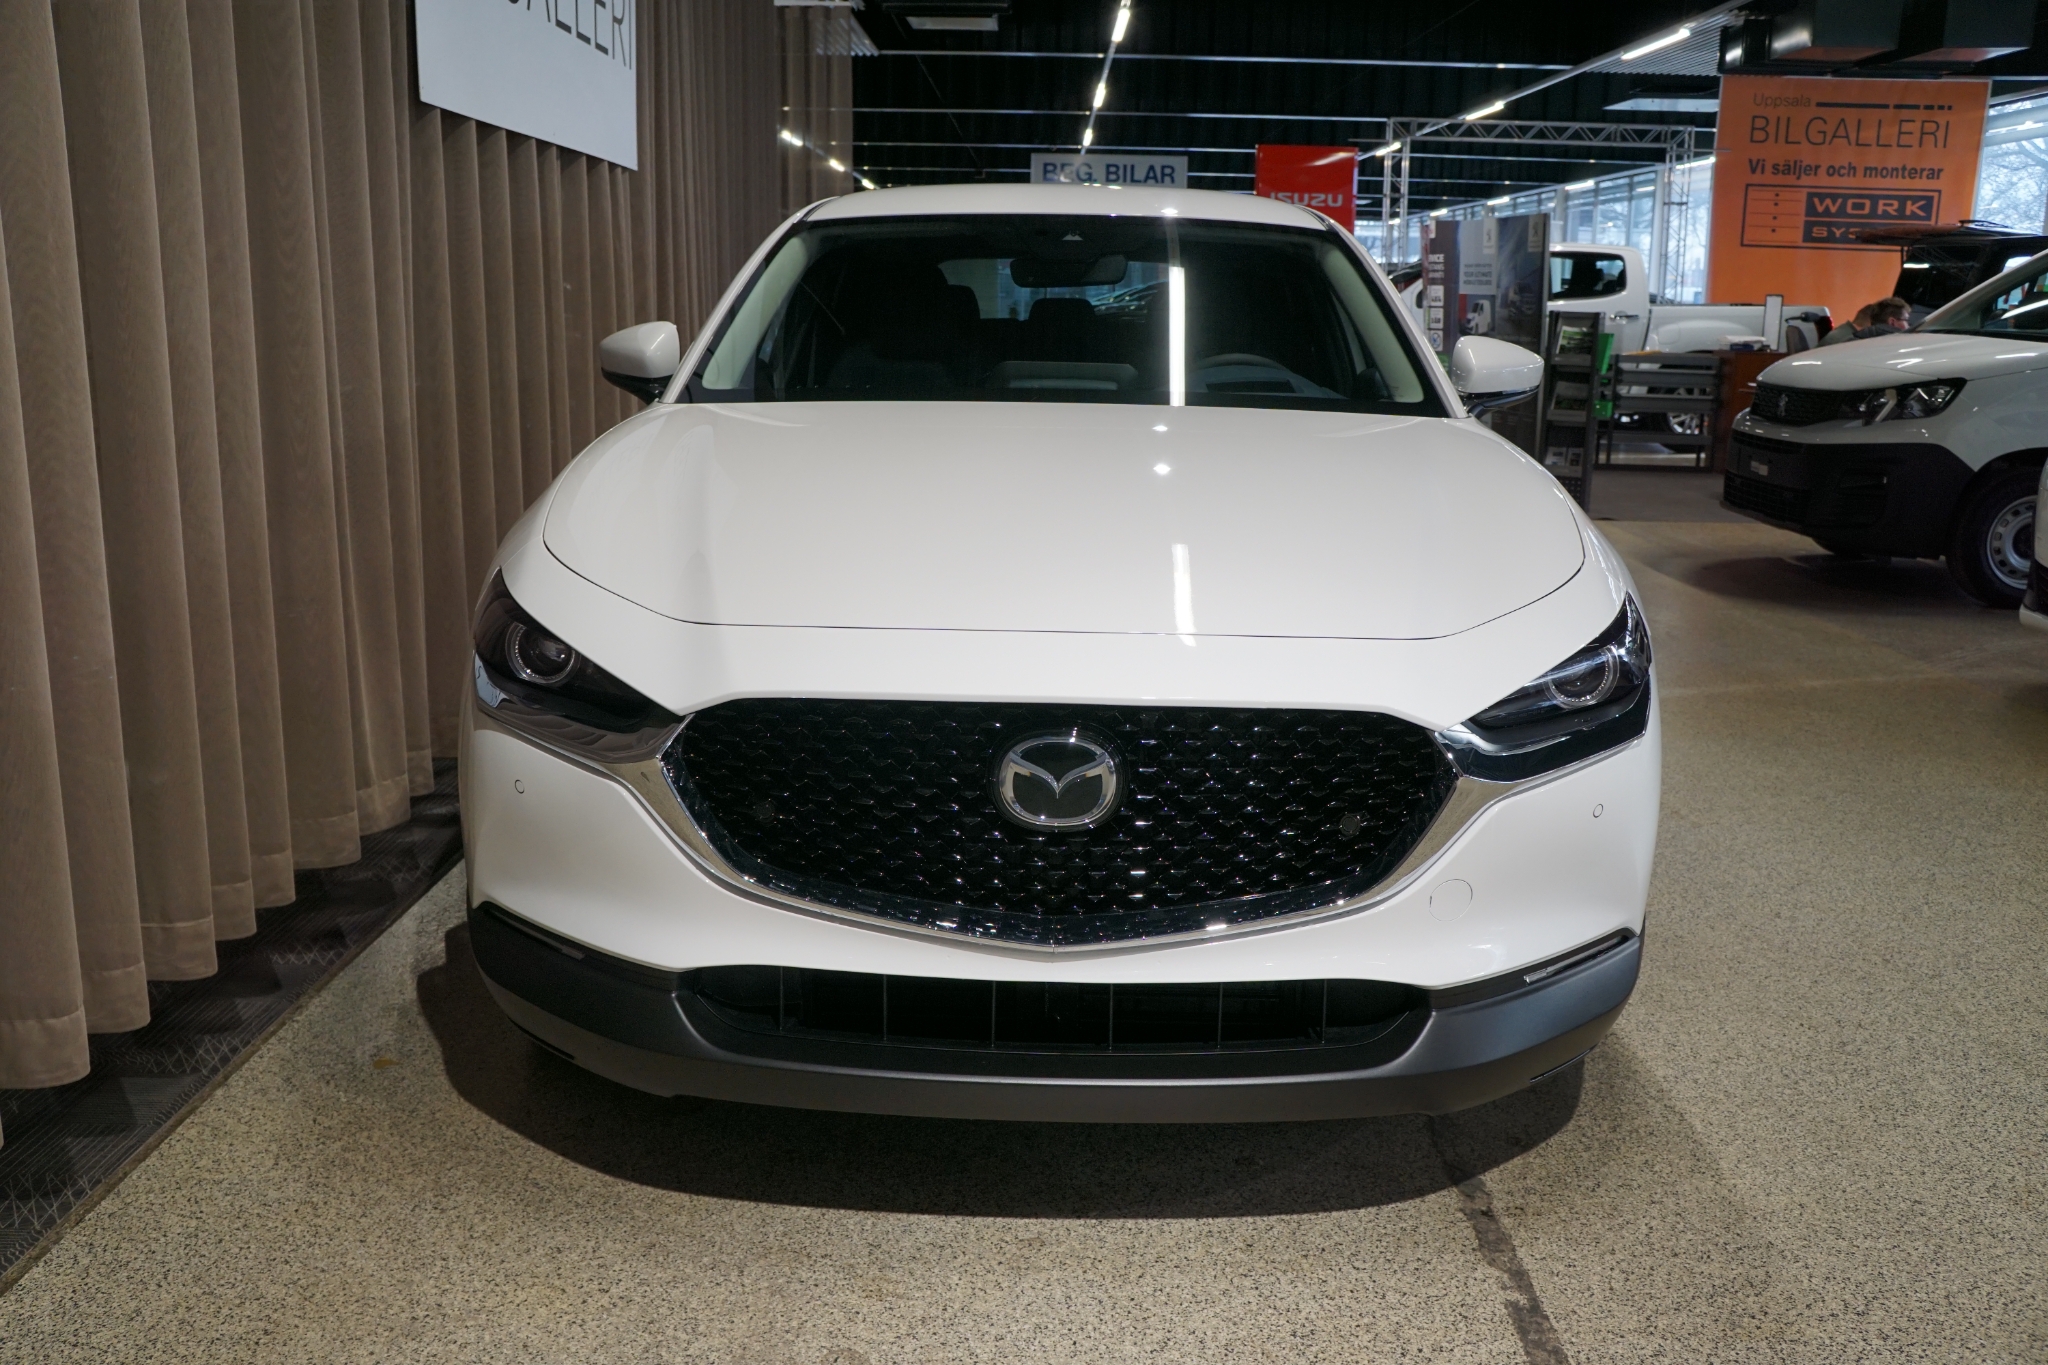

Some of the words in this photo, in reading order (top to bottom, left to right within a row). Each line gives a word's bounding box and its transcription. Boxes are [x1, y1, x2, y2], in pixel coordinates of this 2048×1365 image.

[1753, 93, 1812, 109] Uppsala
[1749, 115, 1950, 149] BILGALLERI
[1105, 163, 1176, 184] BILAR
[1748, 158, 1766, 175] Vi
[1771, 159, 1822, 180] säljer
[1826, 162, 1857, 178] och
[1863, 164, 1945, 181] monterar
[1270, 192, 1344, 207] ISUZU
[1812, 197, 1928, 217] WORK
[1811, 226, 1863, 239] SYS
